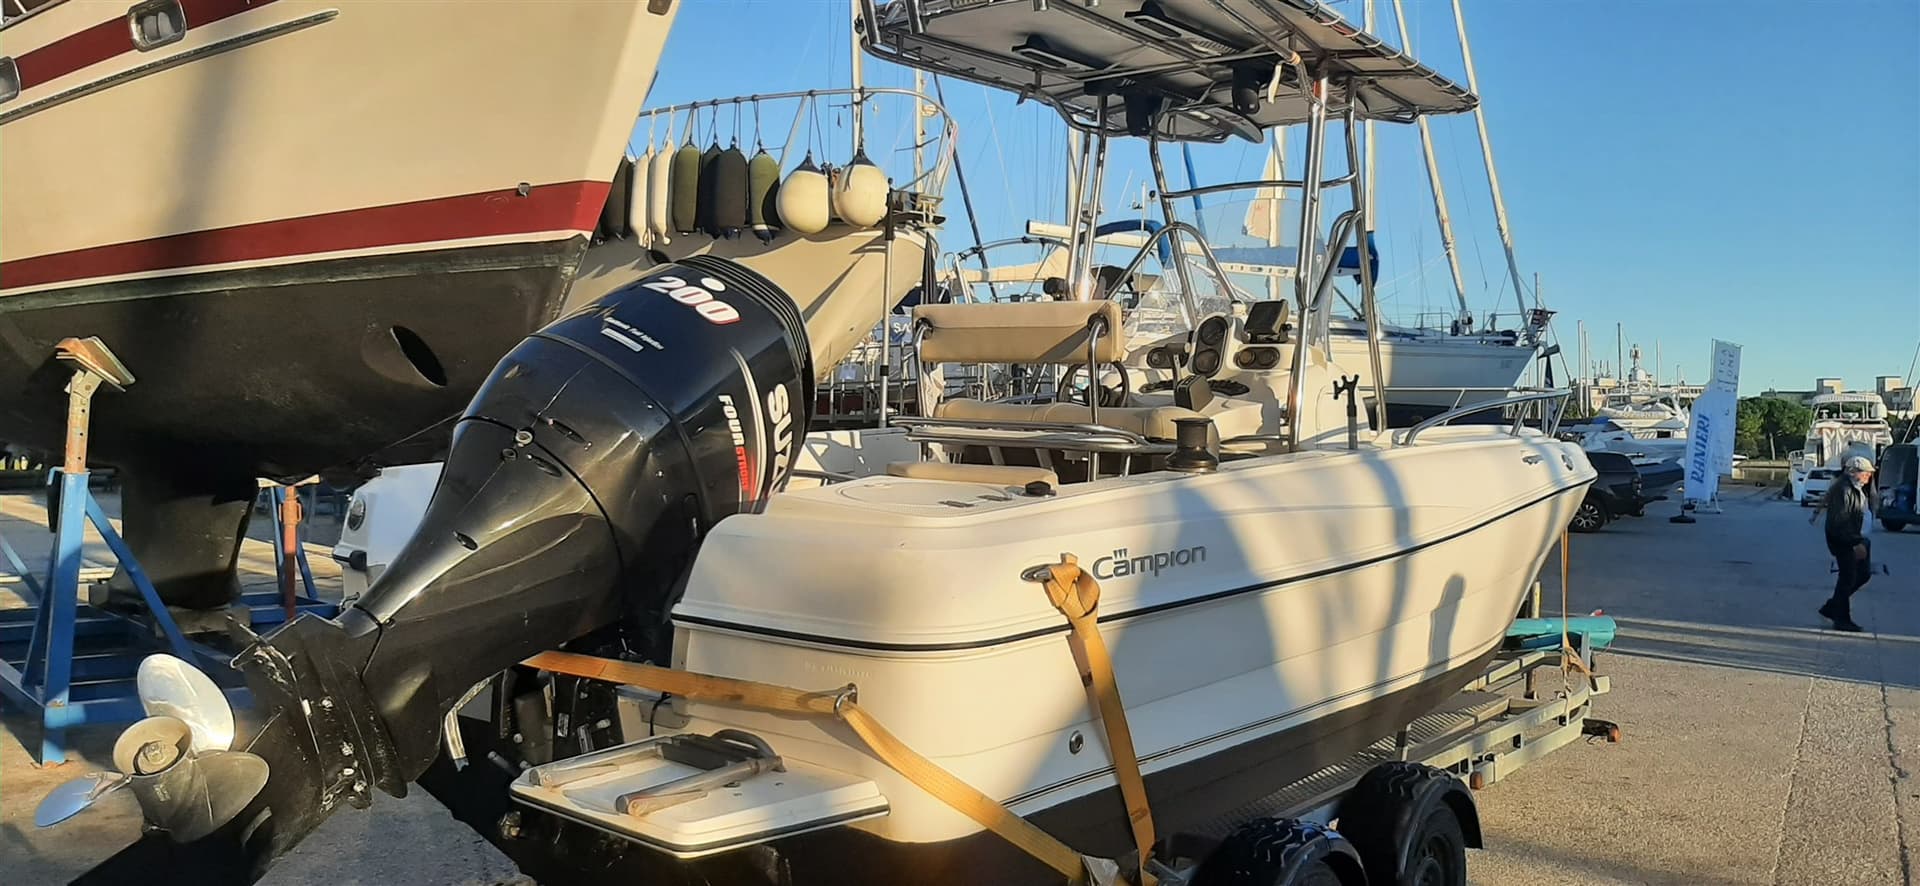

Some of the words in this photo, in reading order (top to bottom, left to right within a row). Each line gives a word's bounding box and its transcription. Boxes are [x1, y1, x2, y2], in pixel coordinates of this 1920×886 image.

[642, 276, 741, 325] 200
[1691, 413, 1710, 484] RANIERI
[1092, 545, 1207, 580] Campion
